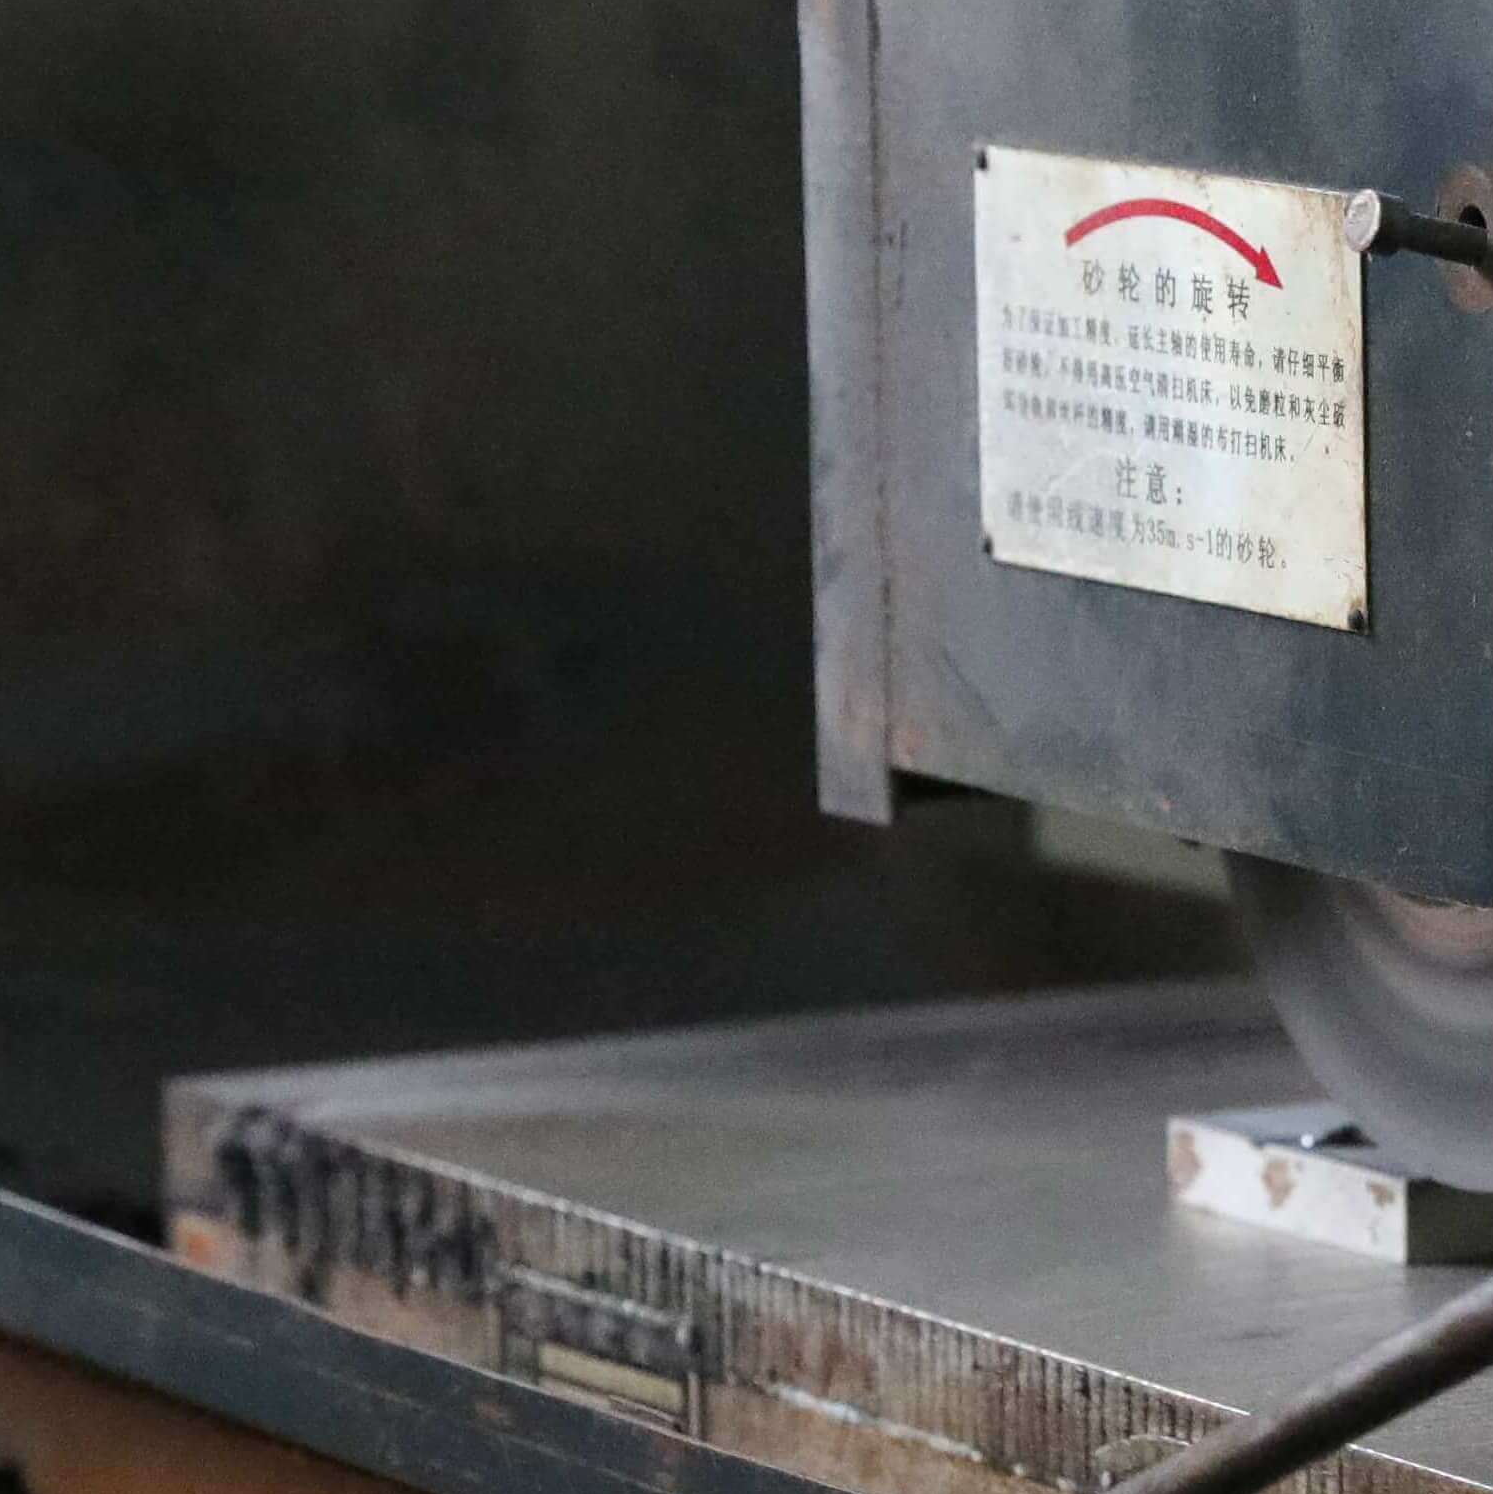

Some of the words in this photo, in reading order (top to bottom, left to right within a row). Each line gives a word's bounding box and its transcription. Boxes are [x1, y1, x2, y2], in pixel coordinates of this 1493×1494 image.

[1082, 258, 1251, 323] 砂轮的旋转
